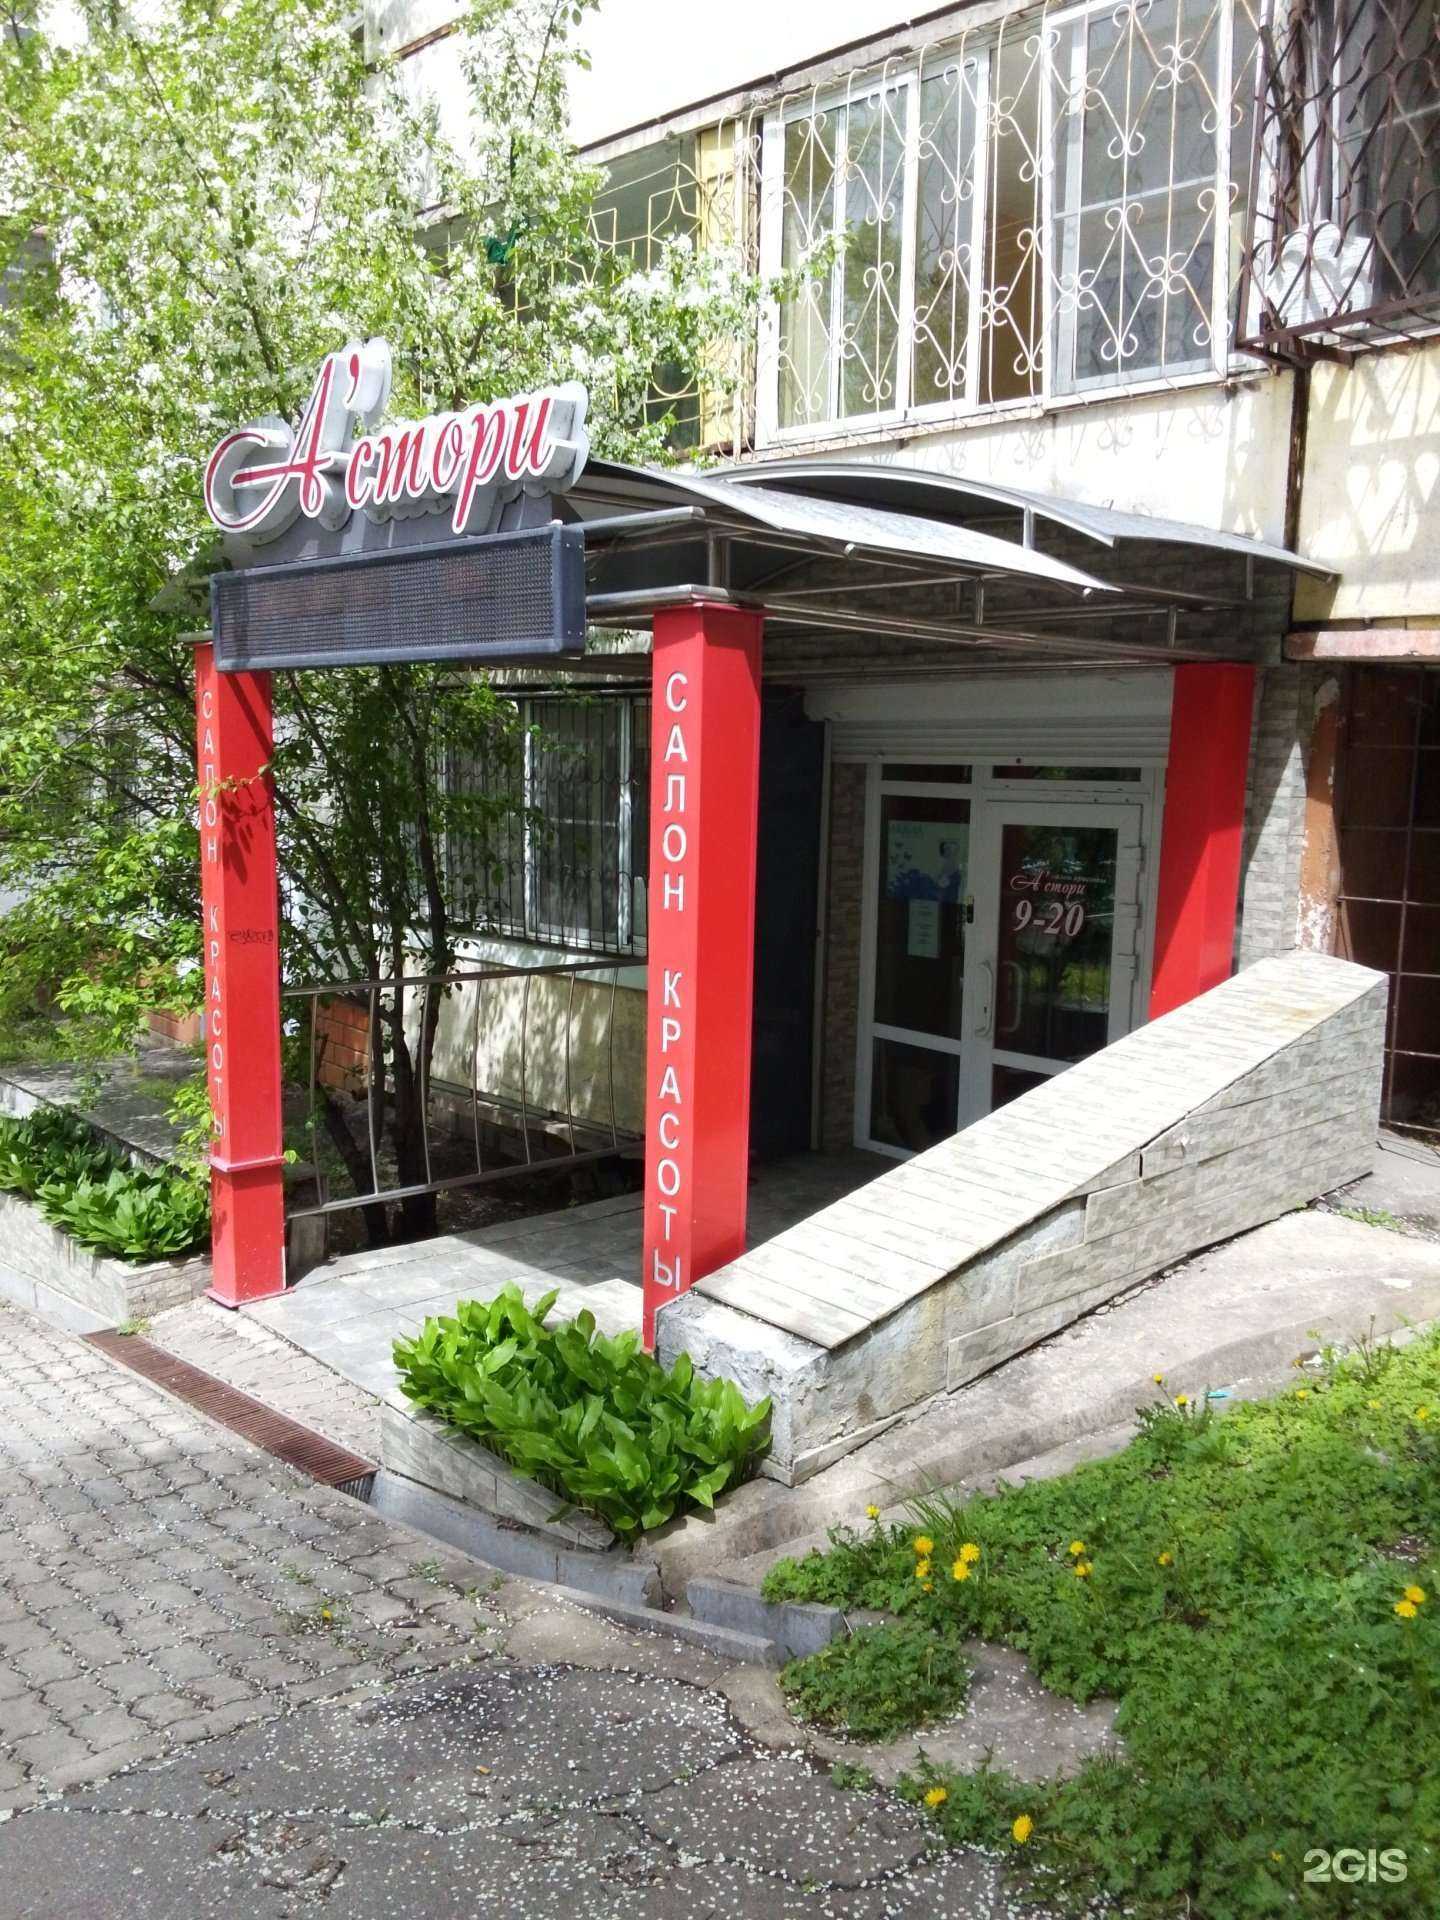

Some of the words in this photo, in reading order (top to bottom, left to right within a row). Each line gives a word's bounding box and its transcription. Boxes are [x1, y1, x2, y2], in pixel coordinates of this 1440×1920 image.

[202, 691, 218, 863] САЛОН
[662, 671, 688, 912] САЛОН
[209, 904, 225, 1137] КРАСОТЫ
[1013, 900, 1084, 936] 9-20
[652, 969, 681, 1291] КРАСОТЫ
